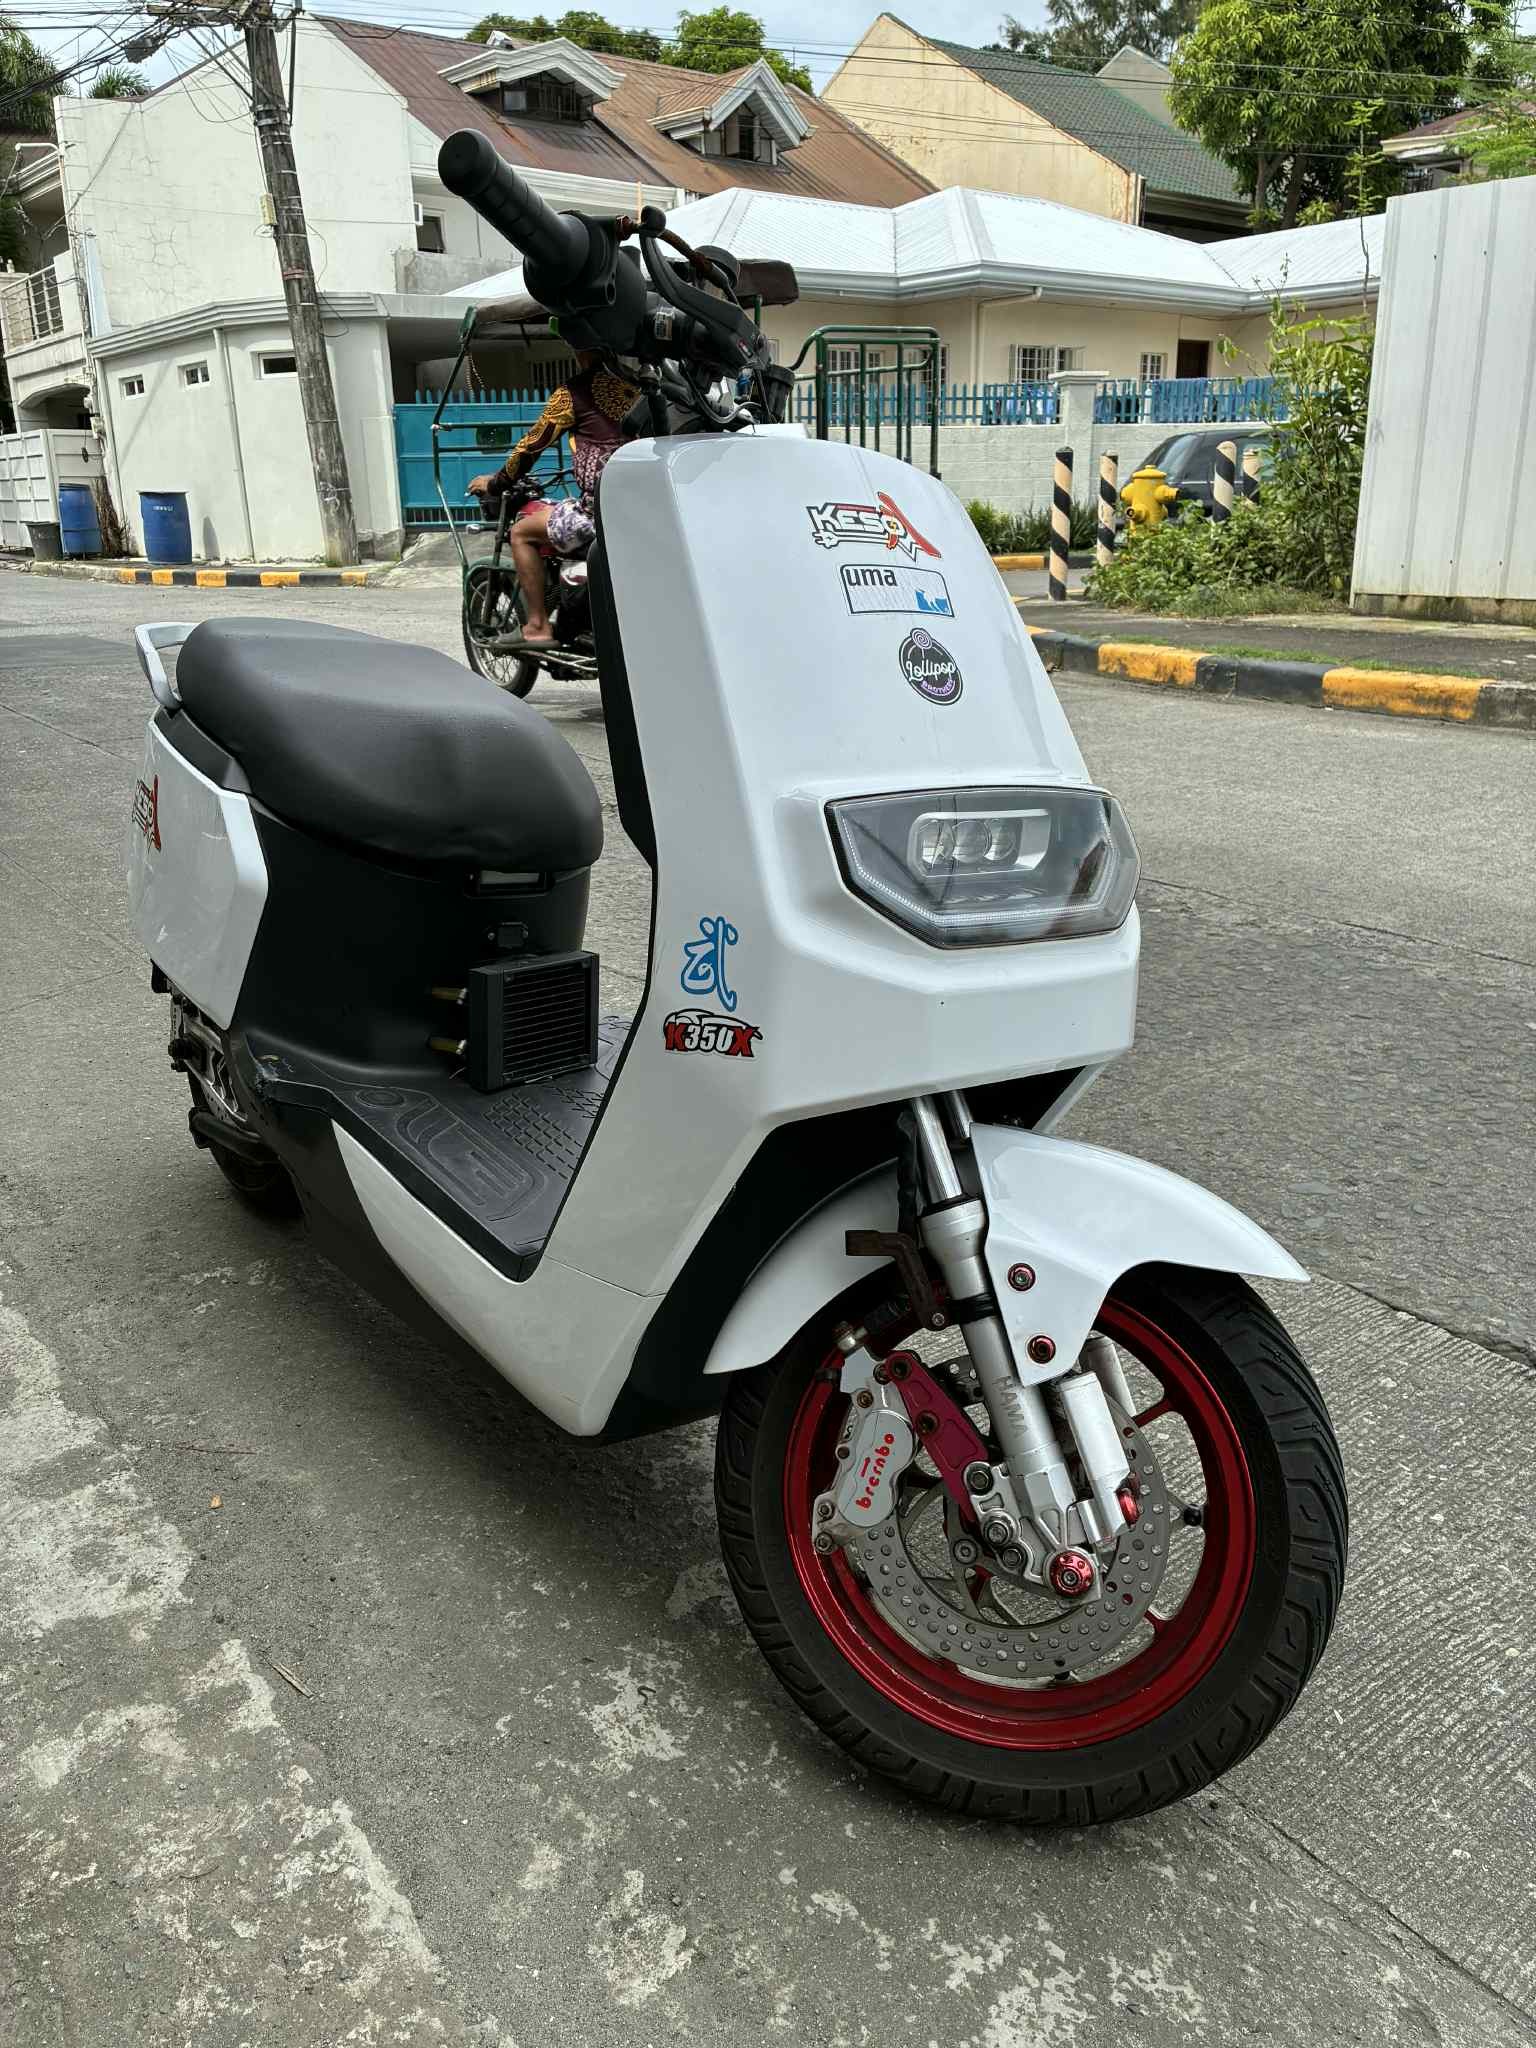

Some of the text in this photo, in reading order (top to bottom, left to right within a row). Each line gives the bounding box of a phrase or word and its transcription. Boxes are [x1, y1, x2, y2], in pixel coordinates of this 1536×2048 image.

[846, 567, 898, 587] uma
[905, 659, 956, 682] Lollipop
[665, 1021, 759, 1057] K350X
